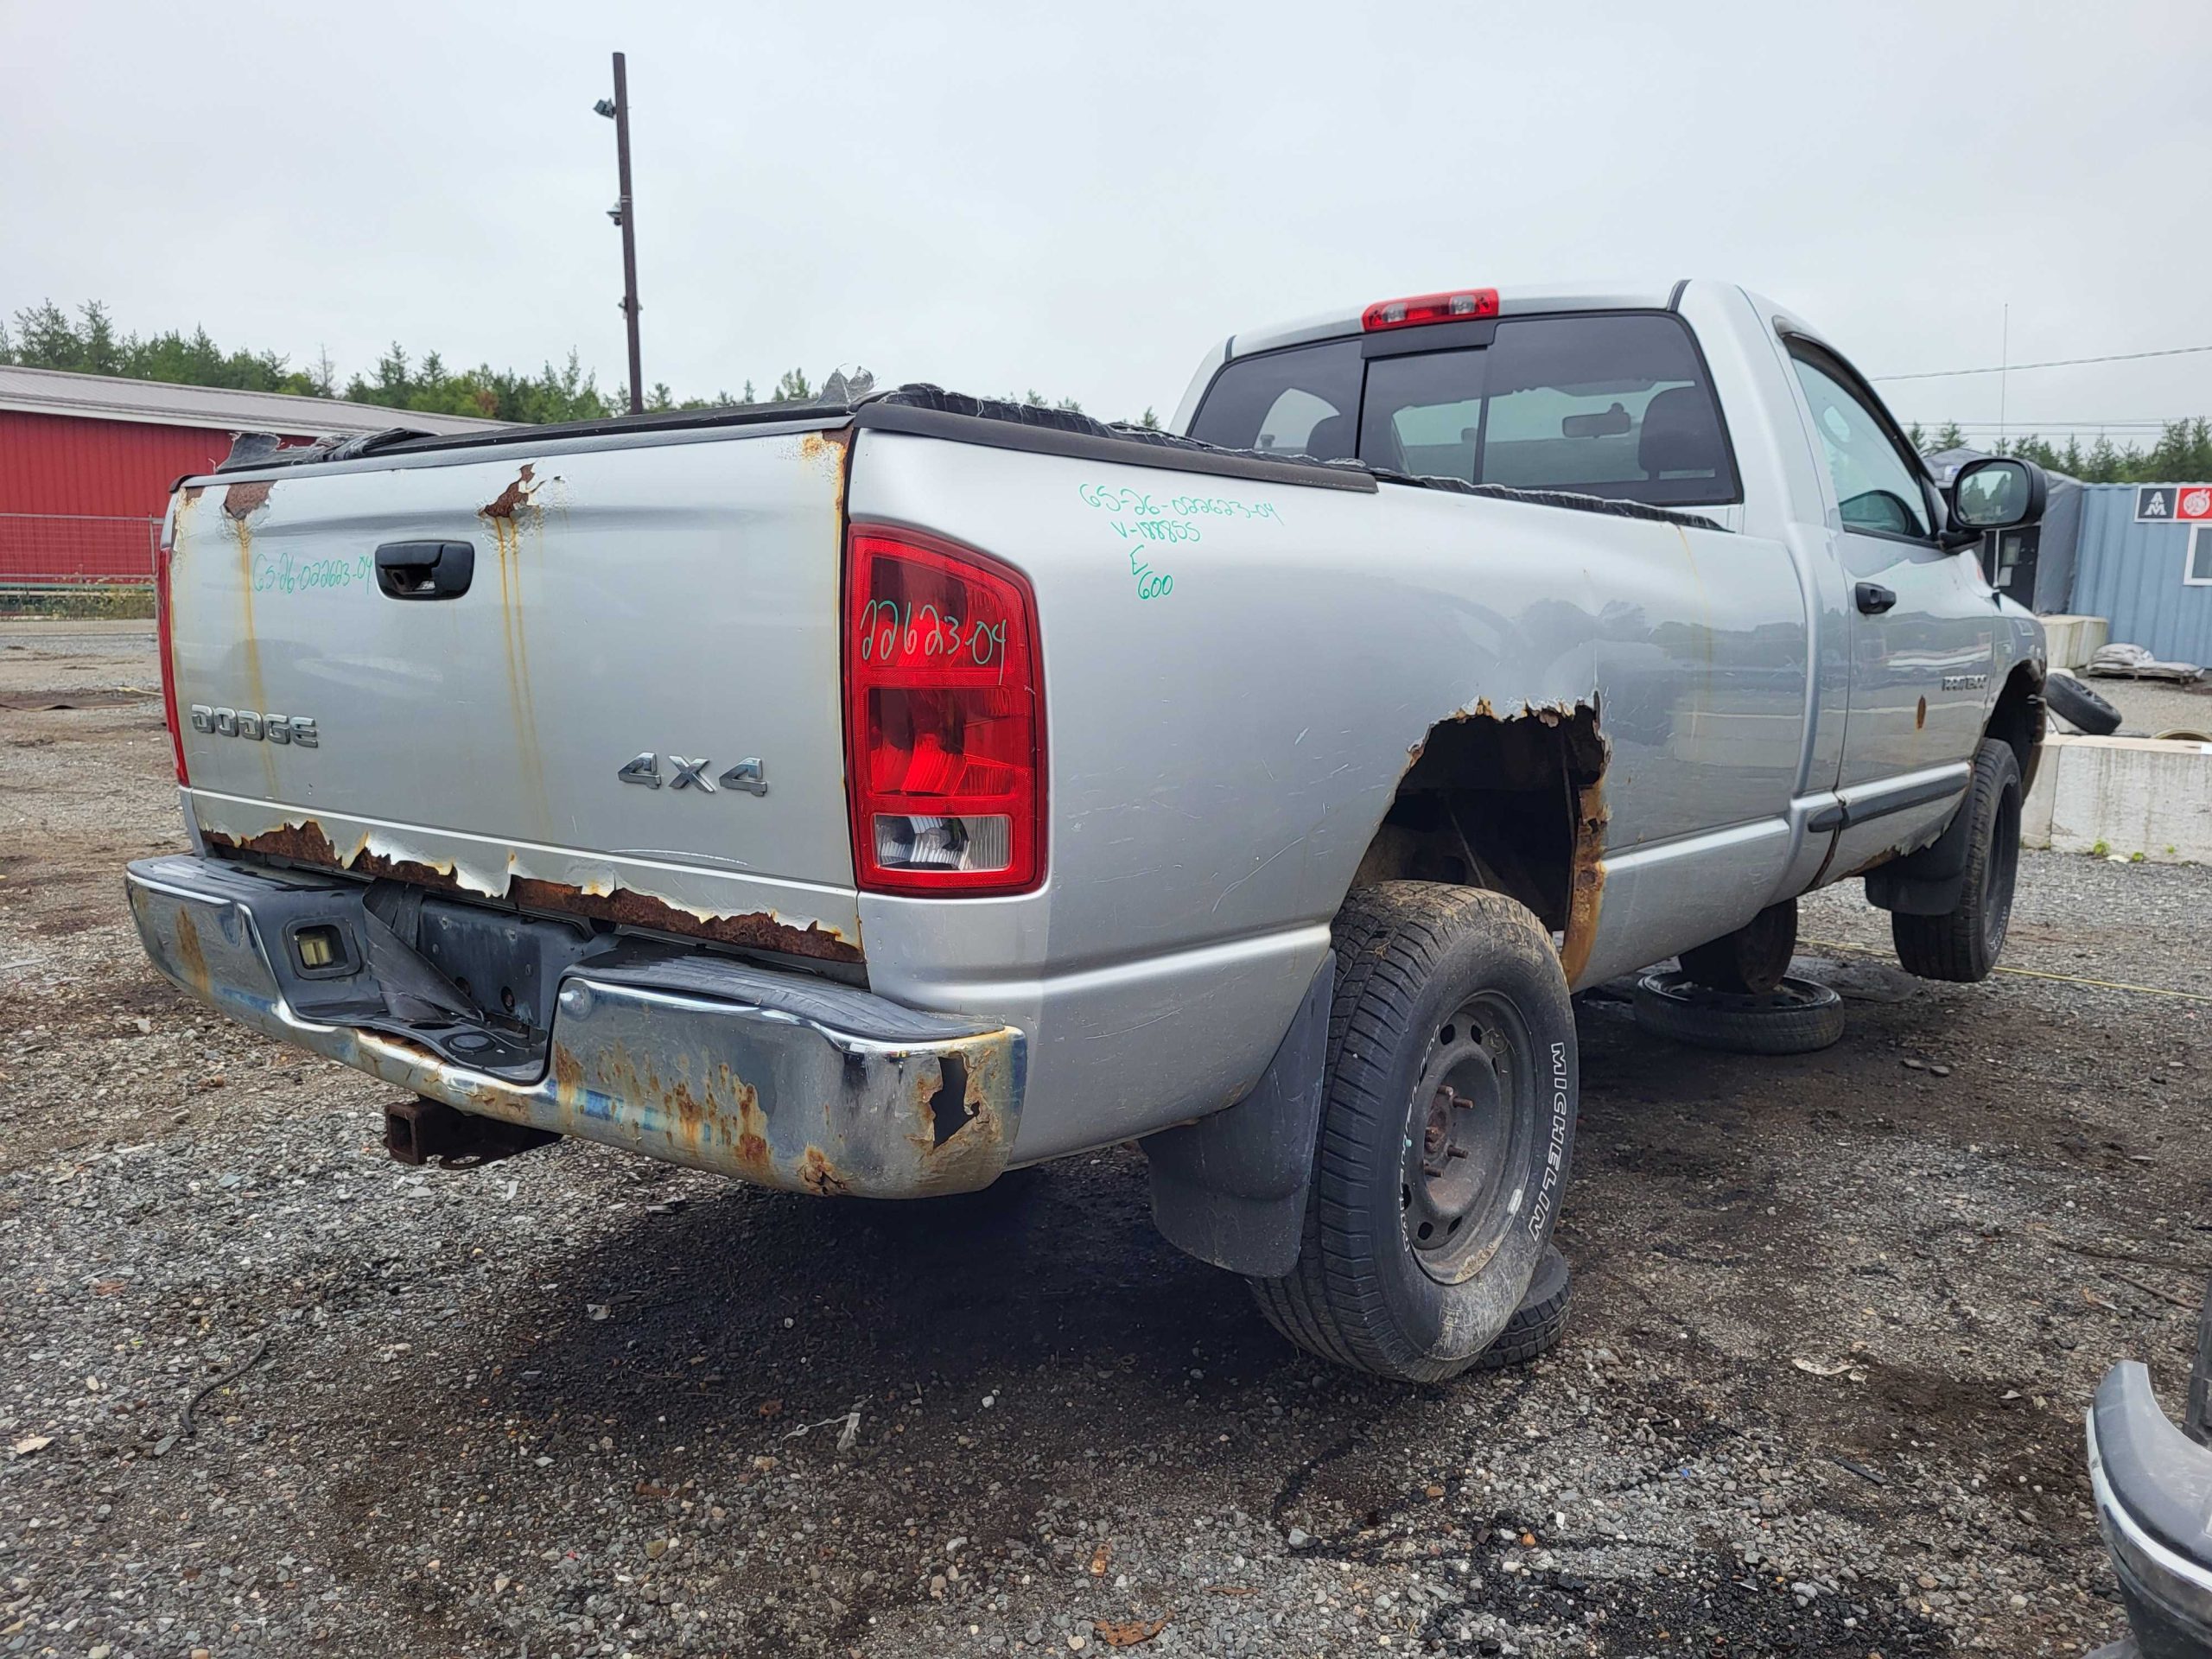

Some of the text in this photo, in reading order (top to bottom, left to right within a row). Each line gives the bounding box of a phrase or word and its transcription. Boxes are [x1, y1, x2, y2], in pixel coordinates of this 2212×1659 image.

[1137, 570, 1173, 600] 600
[860, 599, 1007, 685] 22623-04
[191, 703, 319, 748] DODGE
[1527, 1042, 1567, 1242] MICHELIN
